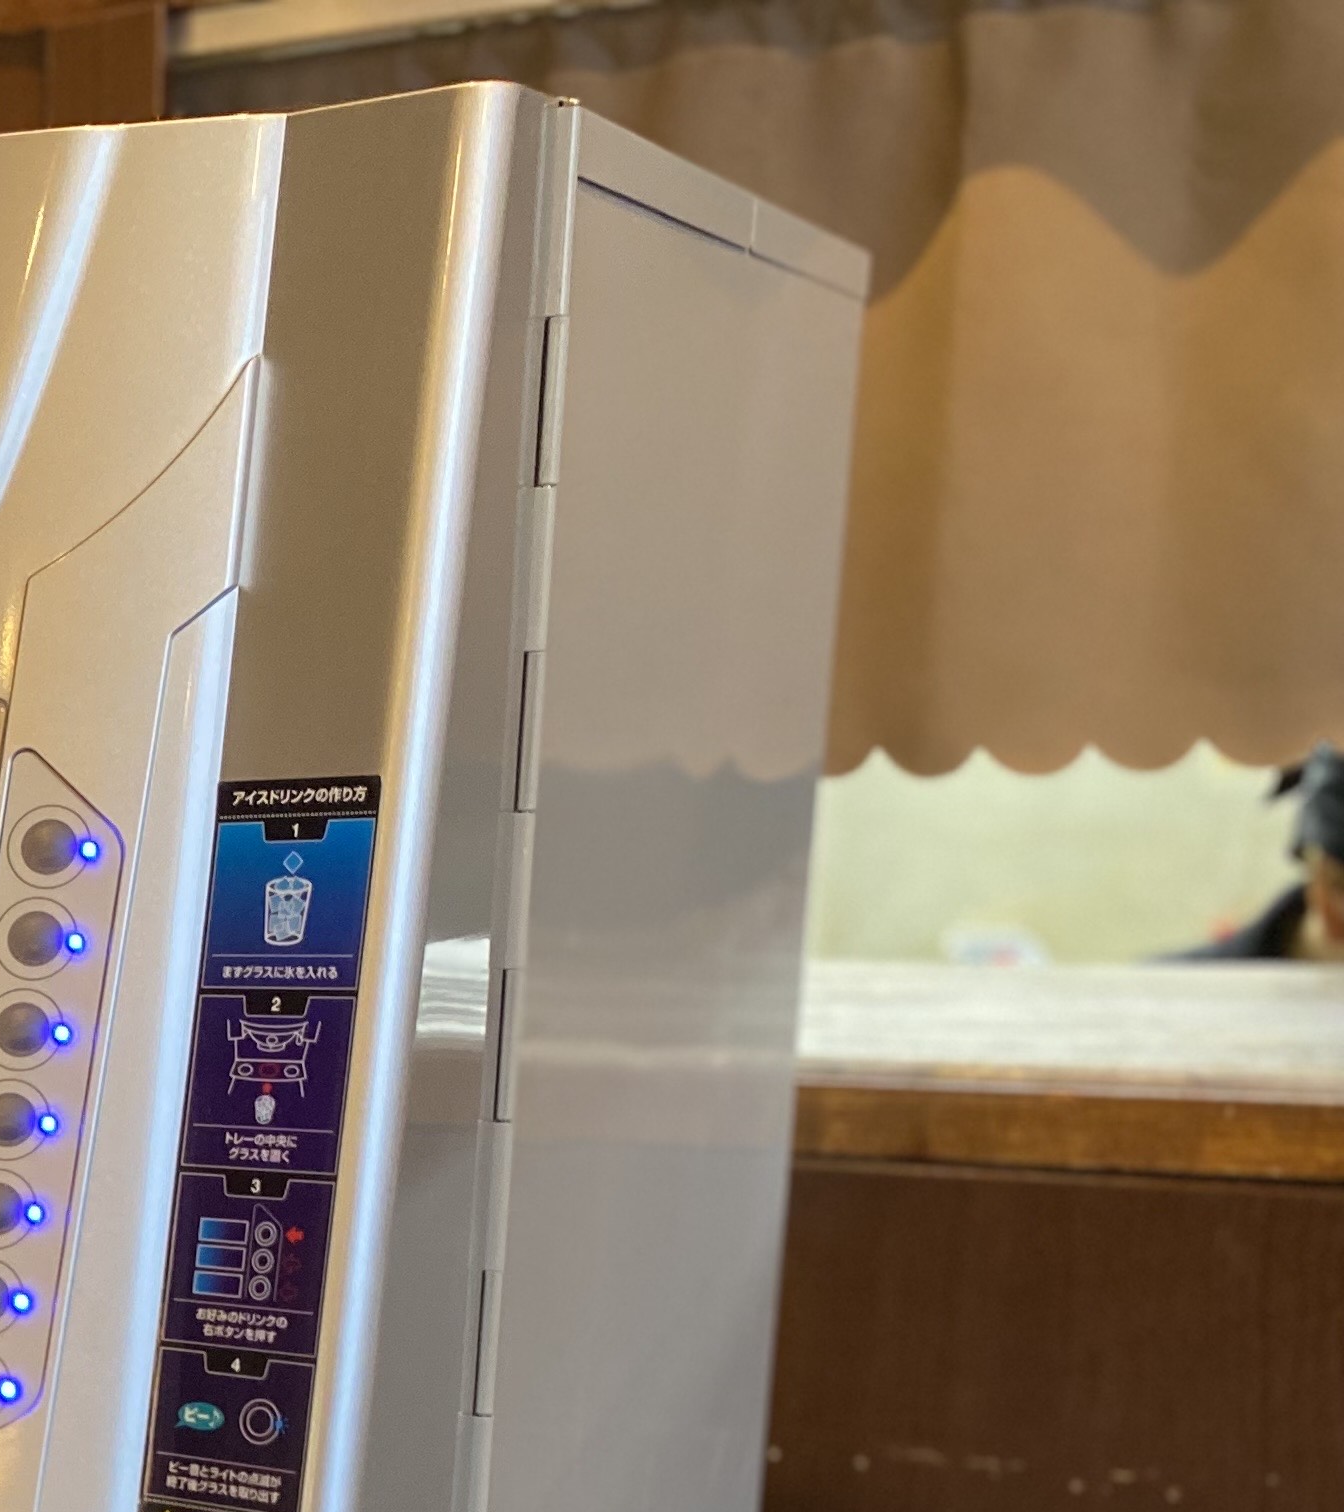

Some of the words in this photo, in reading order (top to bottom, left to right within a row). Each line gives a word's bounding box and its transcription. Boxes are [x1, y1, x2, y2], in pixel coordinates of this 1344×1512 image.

[232, 785, 368, 806] アイスドリンクの作り方
[291, 823, 300, 838] 1
[270, 996, 282, 1012] 2
[250, 1178, 261, 1194] 3
[230, 1356, 242, 1373] 4
